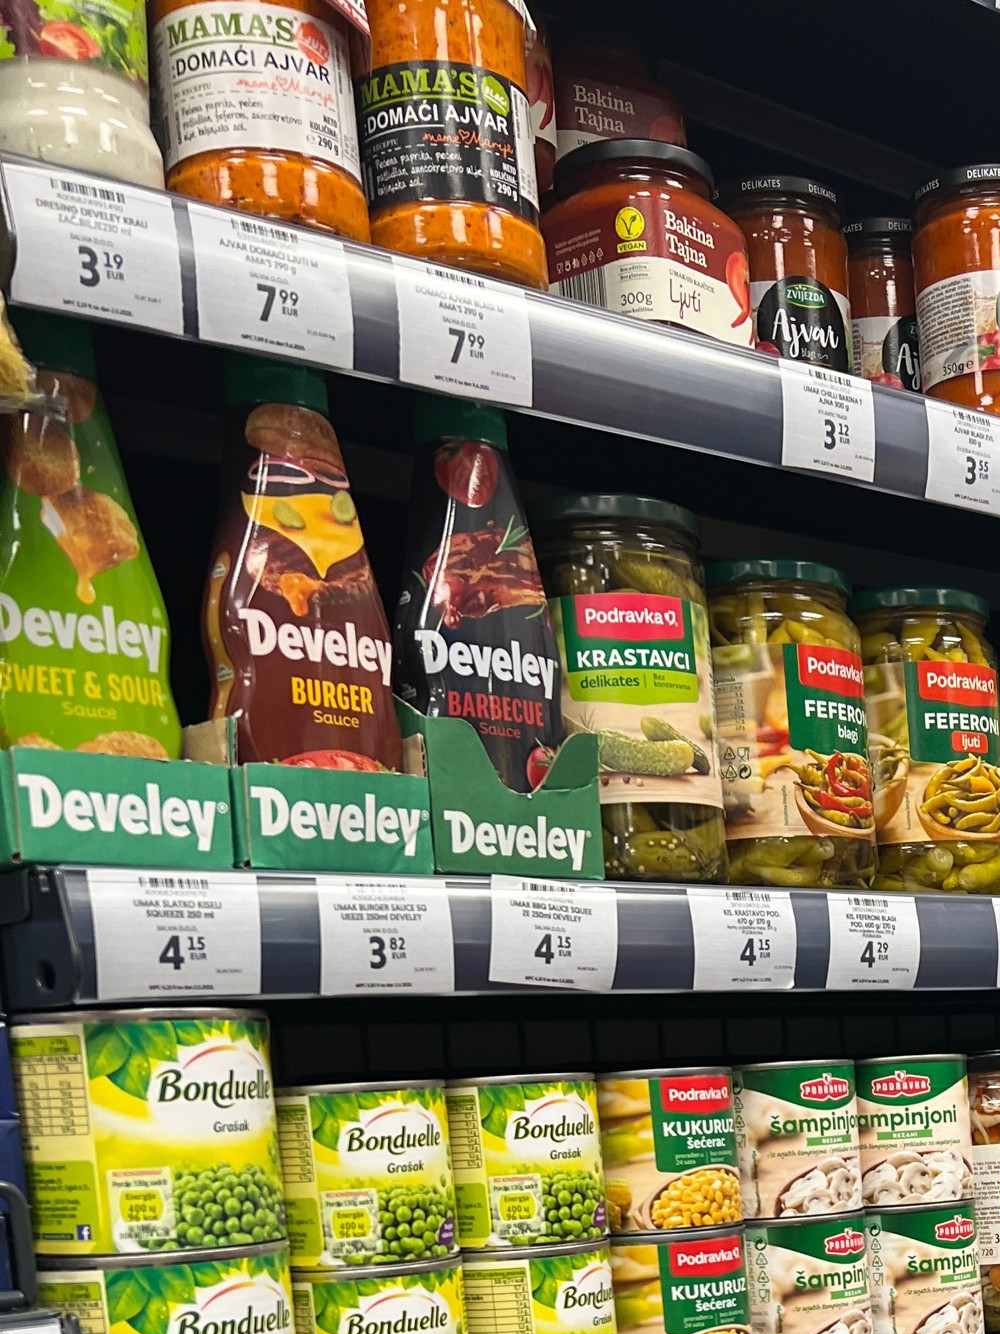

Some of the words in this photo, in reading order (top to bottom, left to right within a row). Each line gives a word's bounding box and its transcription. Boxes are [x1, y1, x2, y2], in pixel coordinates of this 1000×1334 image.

[175, 50, 255, 73] DOMAĆI
[264, 52, 331, 84] AJVAR
[367, 103, 439, 134] DOMAĆI
[445, 108, 509, 136] AJVAR
[664, 210, 714, 249] Bakina
[617, 240, 646, 252] VEGAN
[666, 235, 707, 267] Tajna
[79, 245, 100, 287] 3
[103, 252, 124, 270] 19
[106, 270, 125, 281] EUR
[257, 284, 275, 322] 7
[278, 290, 299, 306] 99
[621, 290, 653, 307] 300g
[786, 287, 825, 306] ZVIJEZDA
[773, 308, 839, 358] Ajvar
[584, 607, 664, 626] Podravka
[239, 608, 392, 686] Develey
[415, 629, 555, 699] Develey
[577, 648, 690, 671] KRASTAVCI
[580, 673, 640, 690] delikates
[926, 670, 988, 693] Podravka
[291, 677, 373, 714] BURGER
[314, 709, 360, 729] Sauce
[447, 691, 543, 727] BARBECUE
[924, 711, 1000, 737] FEFERONI
[961, 733, 981, 751] ljuti
[18, 773, 216, 851] Develey
[250, 785, 420, 856] Develey
[159, 935, 184, 970] 4
[187, 937, 205, 951] 15
[191, 951, 207, 961] EUR
[158, 1069, 270, 1108] Bonduelle
[669, 1086, 719, 1101] Podravka
[213, 1118, 250, 1133] Grašak
[663, 1117, 733, 1136] KUKURUZ
[860, 1105, 956, 1130] ampinjoni
[346, 1124, 440, 1155] Bonduelle
[687, 1135, 725, 1150] šećerac
[387, 1160, 424, 1173] Grašak
